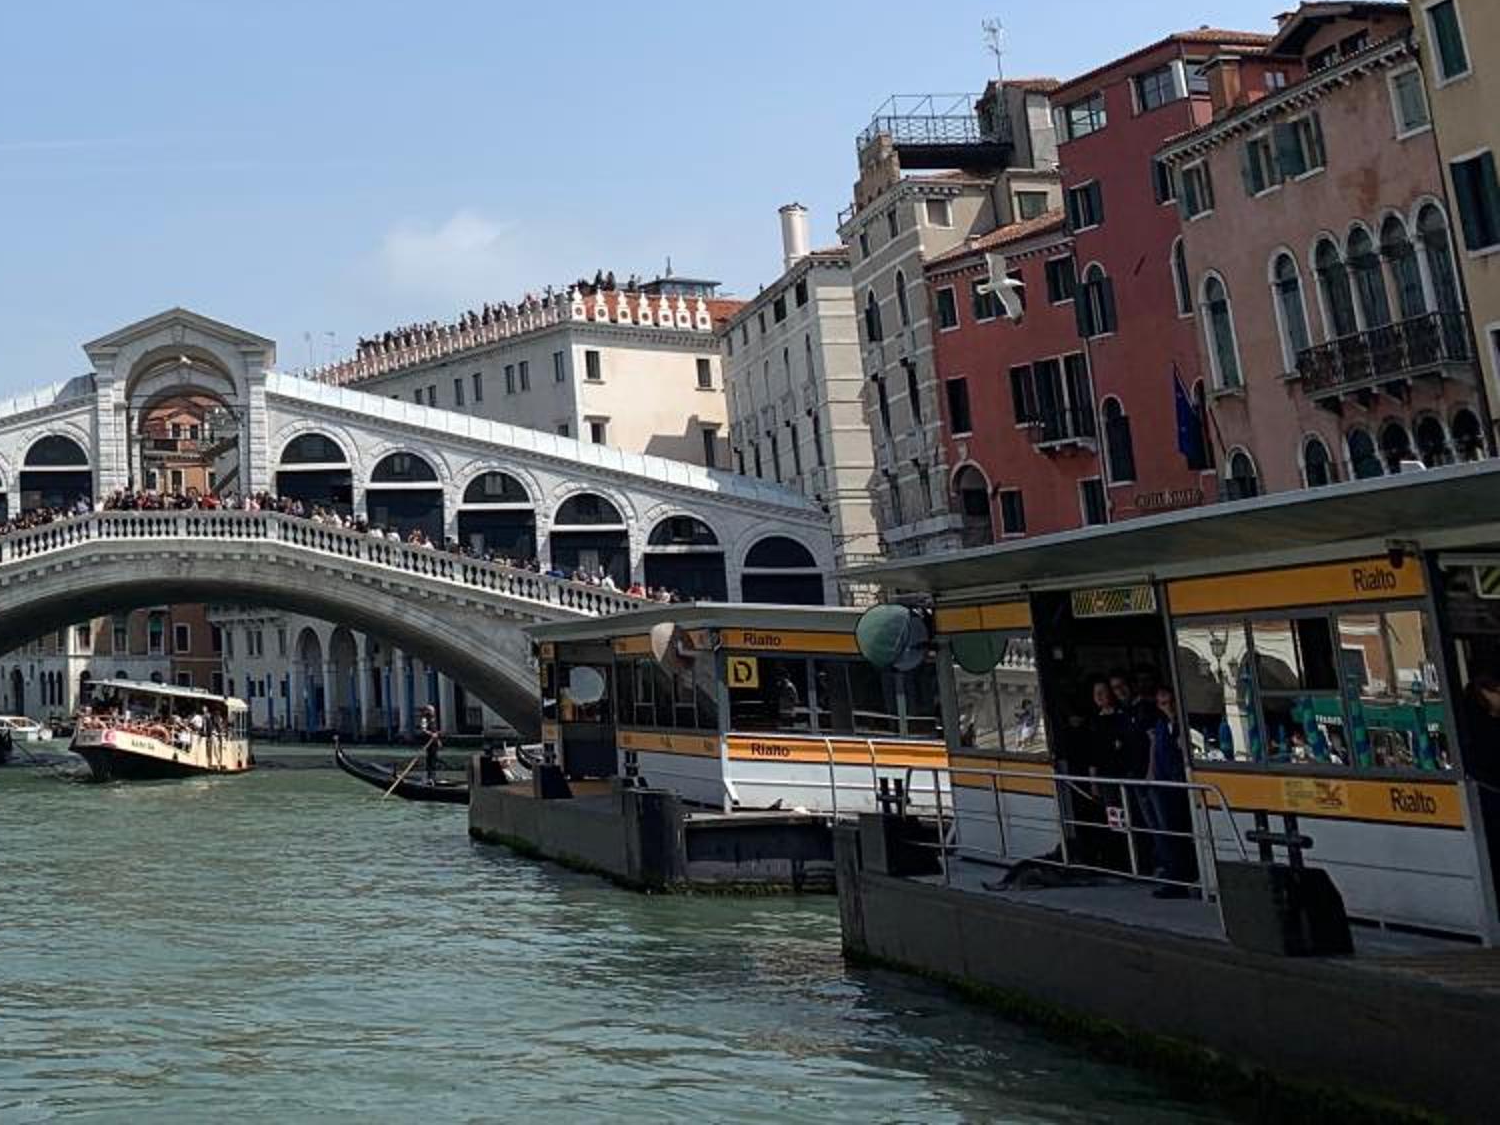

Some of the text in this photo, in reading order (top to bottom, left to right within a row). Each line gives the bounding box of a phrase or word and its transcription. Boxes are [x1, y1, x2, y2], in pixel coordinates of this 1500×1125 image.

[1353, 566, 1398, 592] Rialto
[743, 632, 782, 646] Rialto
[733, 660, 753, 683] D
[750, 742, 791, 757] Rialto
[1389, 787, 1437, 815] Rialto
